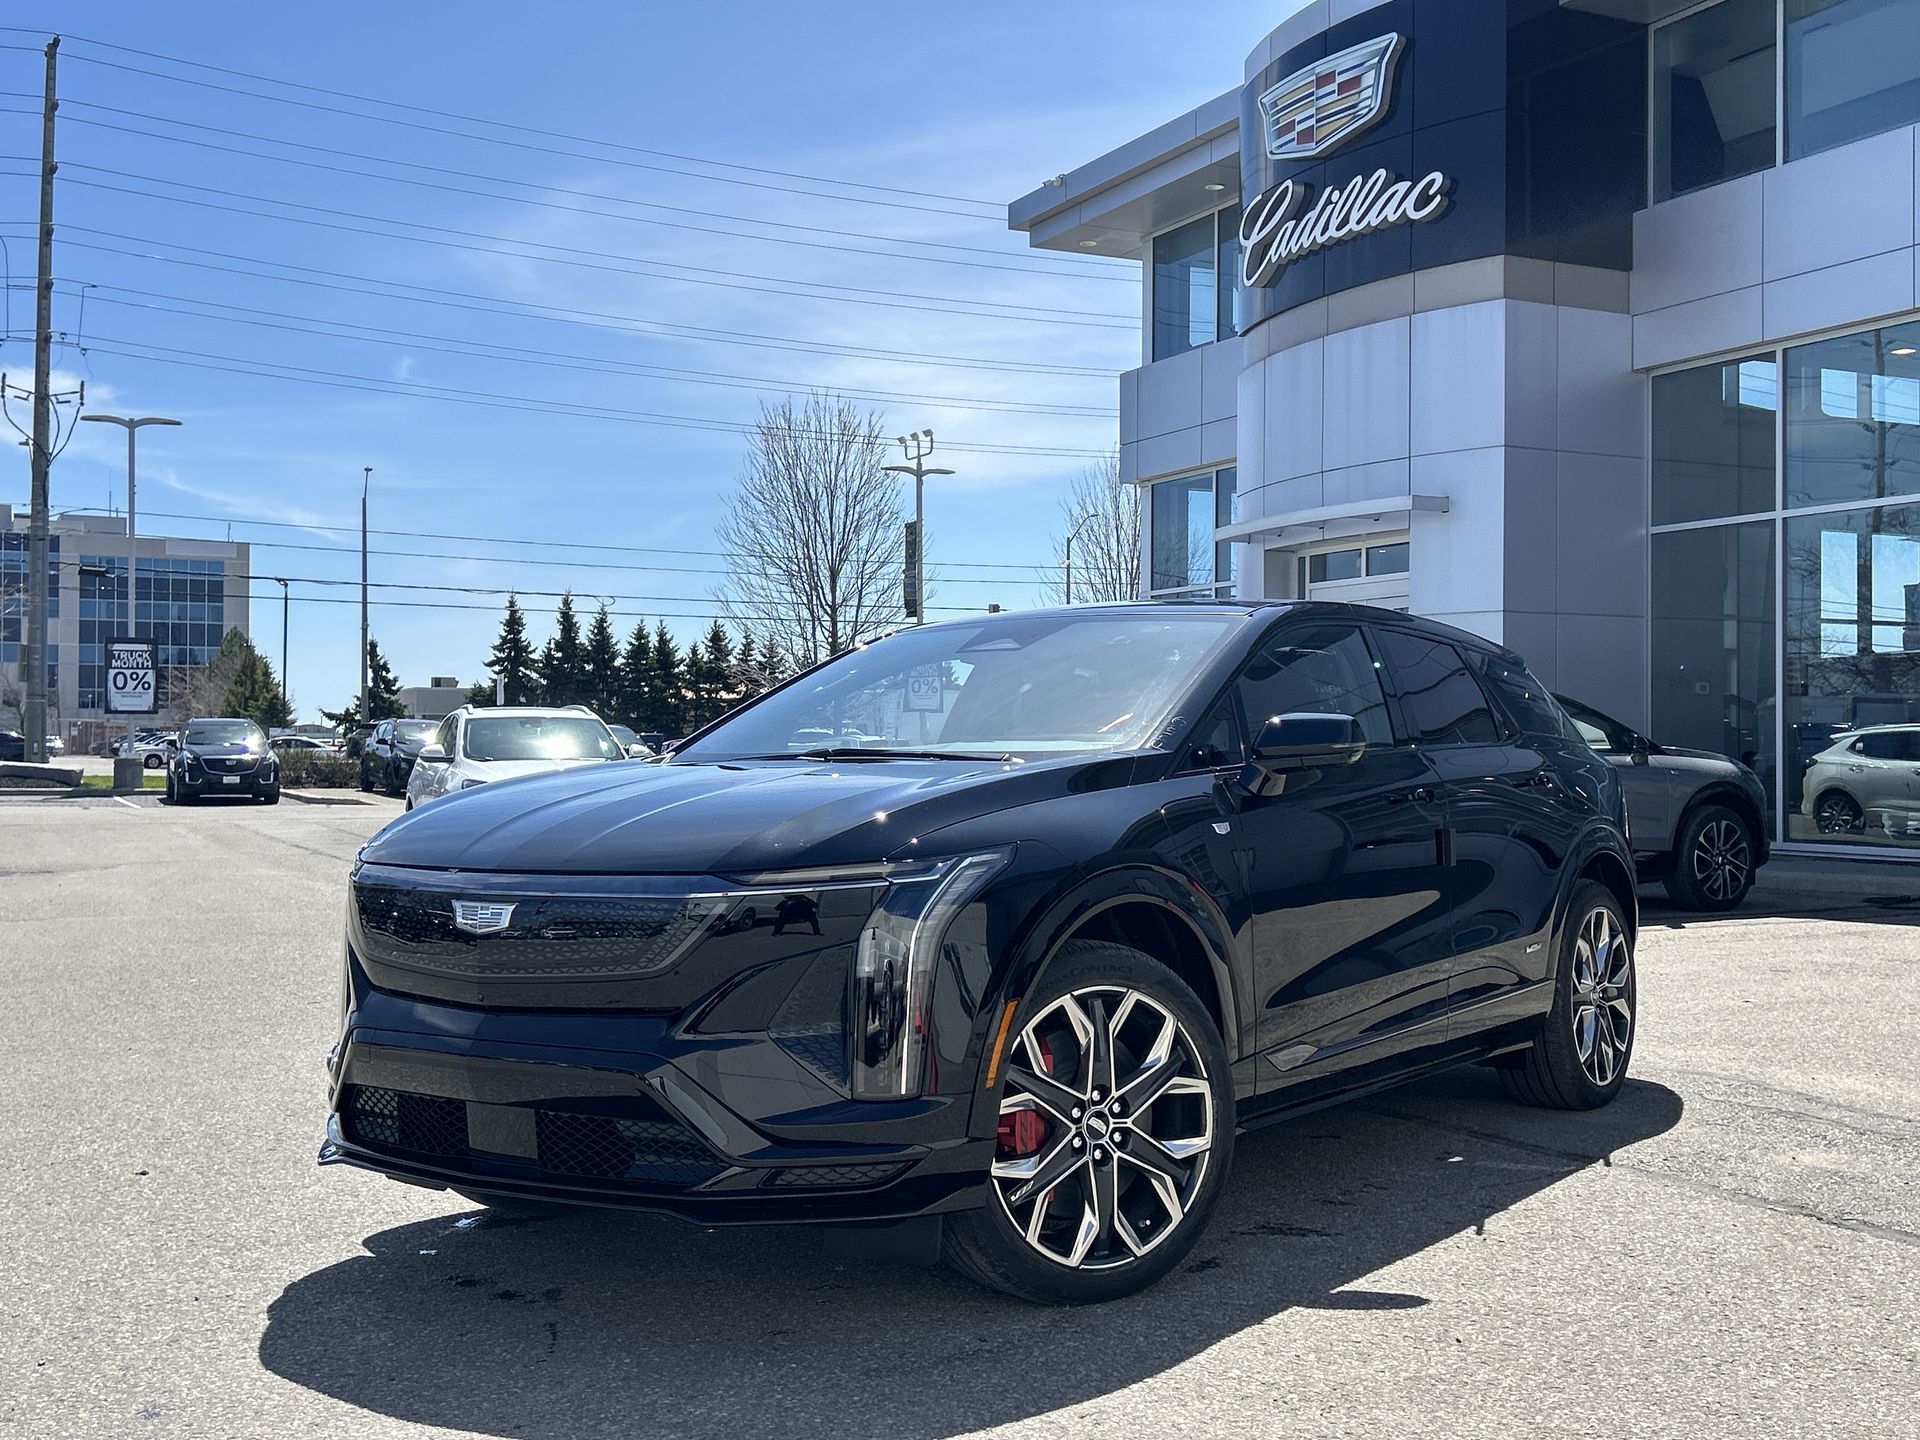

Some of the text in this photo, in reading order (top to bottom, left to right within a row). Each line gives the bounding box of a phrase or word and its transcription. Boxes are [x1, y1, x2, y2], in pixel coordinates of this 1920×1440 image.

[1239, 168, 1445, 287] Cadillac
[112, 650, 151, 660] TRUCK
[111, 659, 152, 668] MONTH
[112, 671, 152, 691] 0%
[911, 679, 939, 694] 0%
